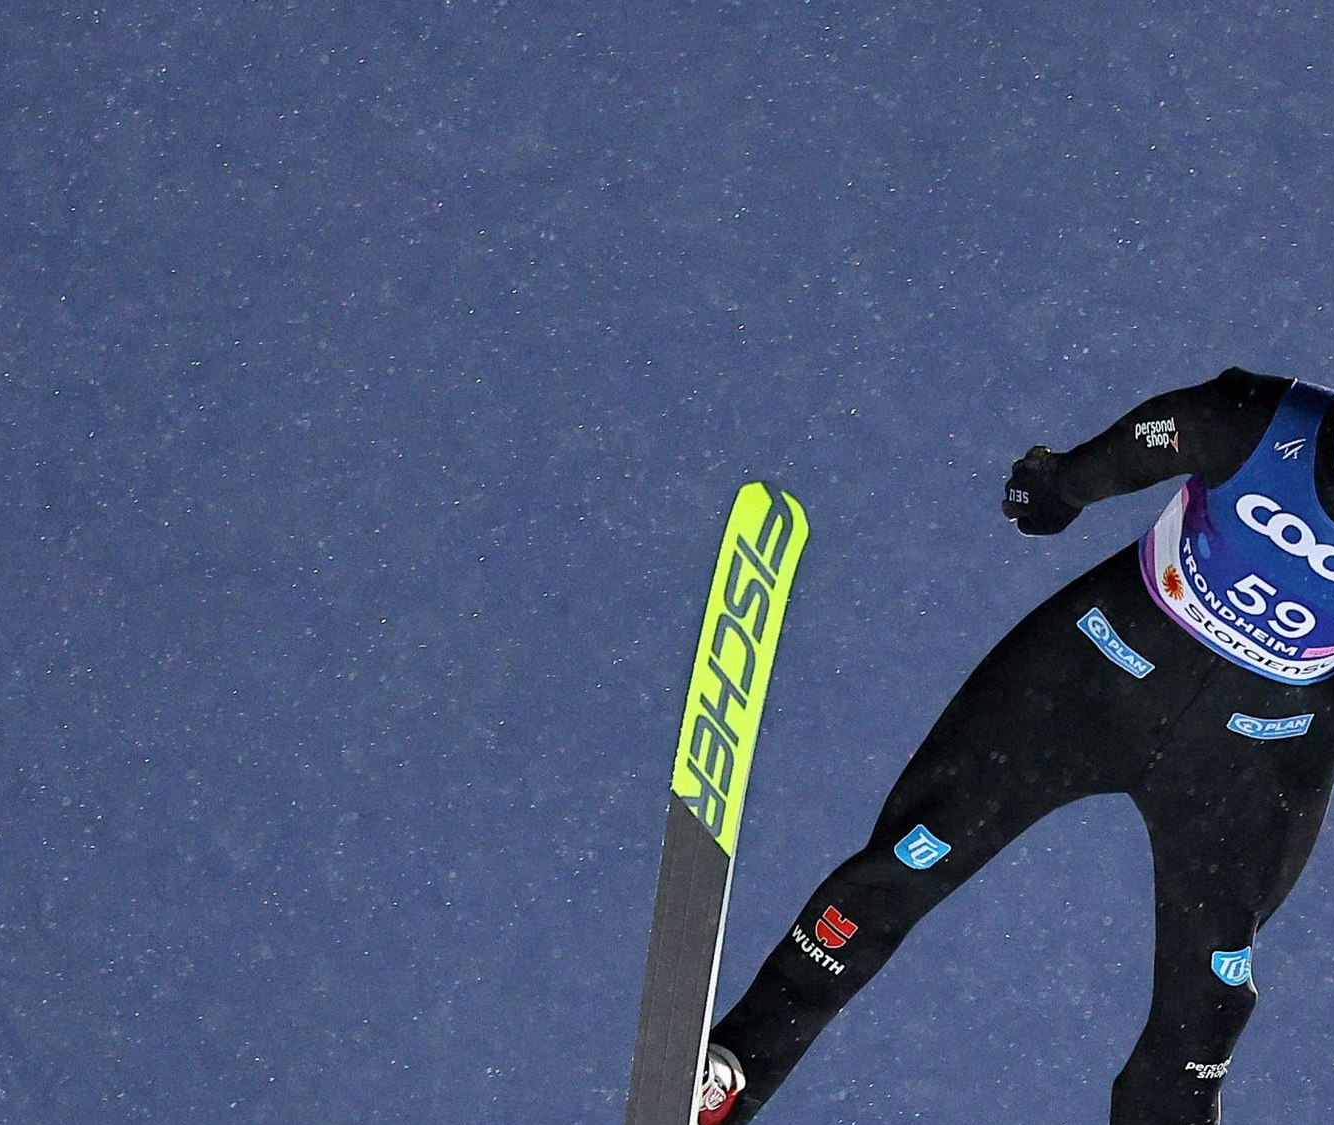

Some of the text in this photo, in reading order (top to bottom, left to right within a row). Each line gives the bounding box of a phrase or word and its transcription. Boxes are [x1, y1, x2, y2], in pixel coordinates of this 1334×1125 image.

[1135, 417, 1175, 440] personal
[1146, 432, 1169, 449] shop
[1183, 537, 1299, 657] TRONDHEIM
[1227, 573, 1316, 639] 59
[680, 482, 794, 838] FISCHER
[792, 924, 846, 976] WÜRTH
